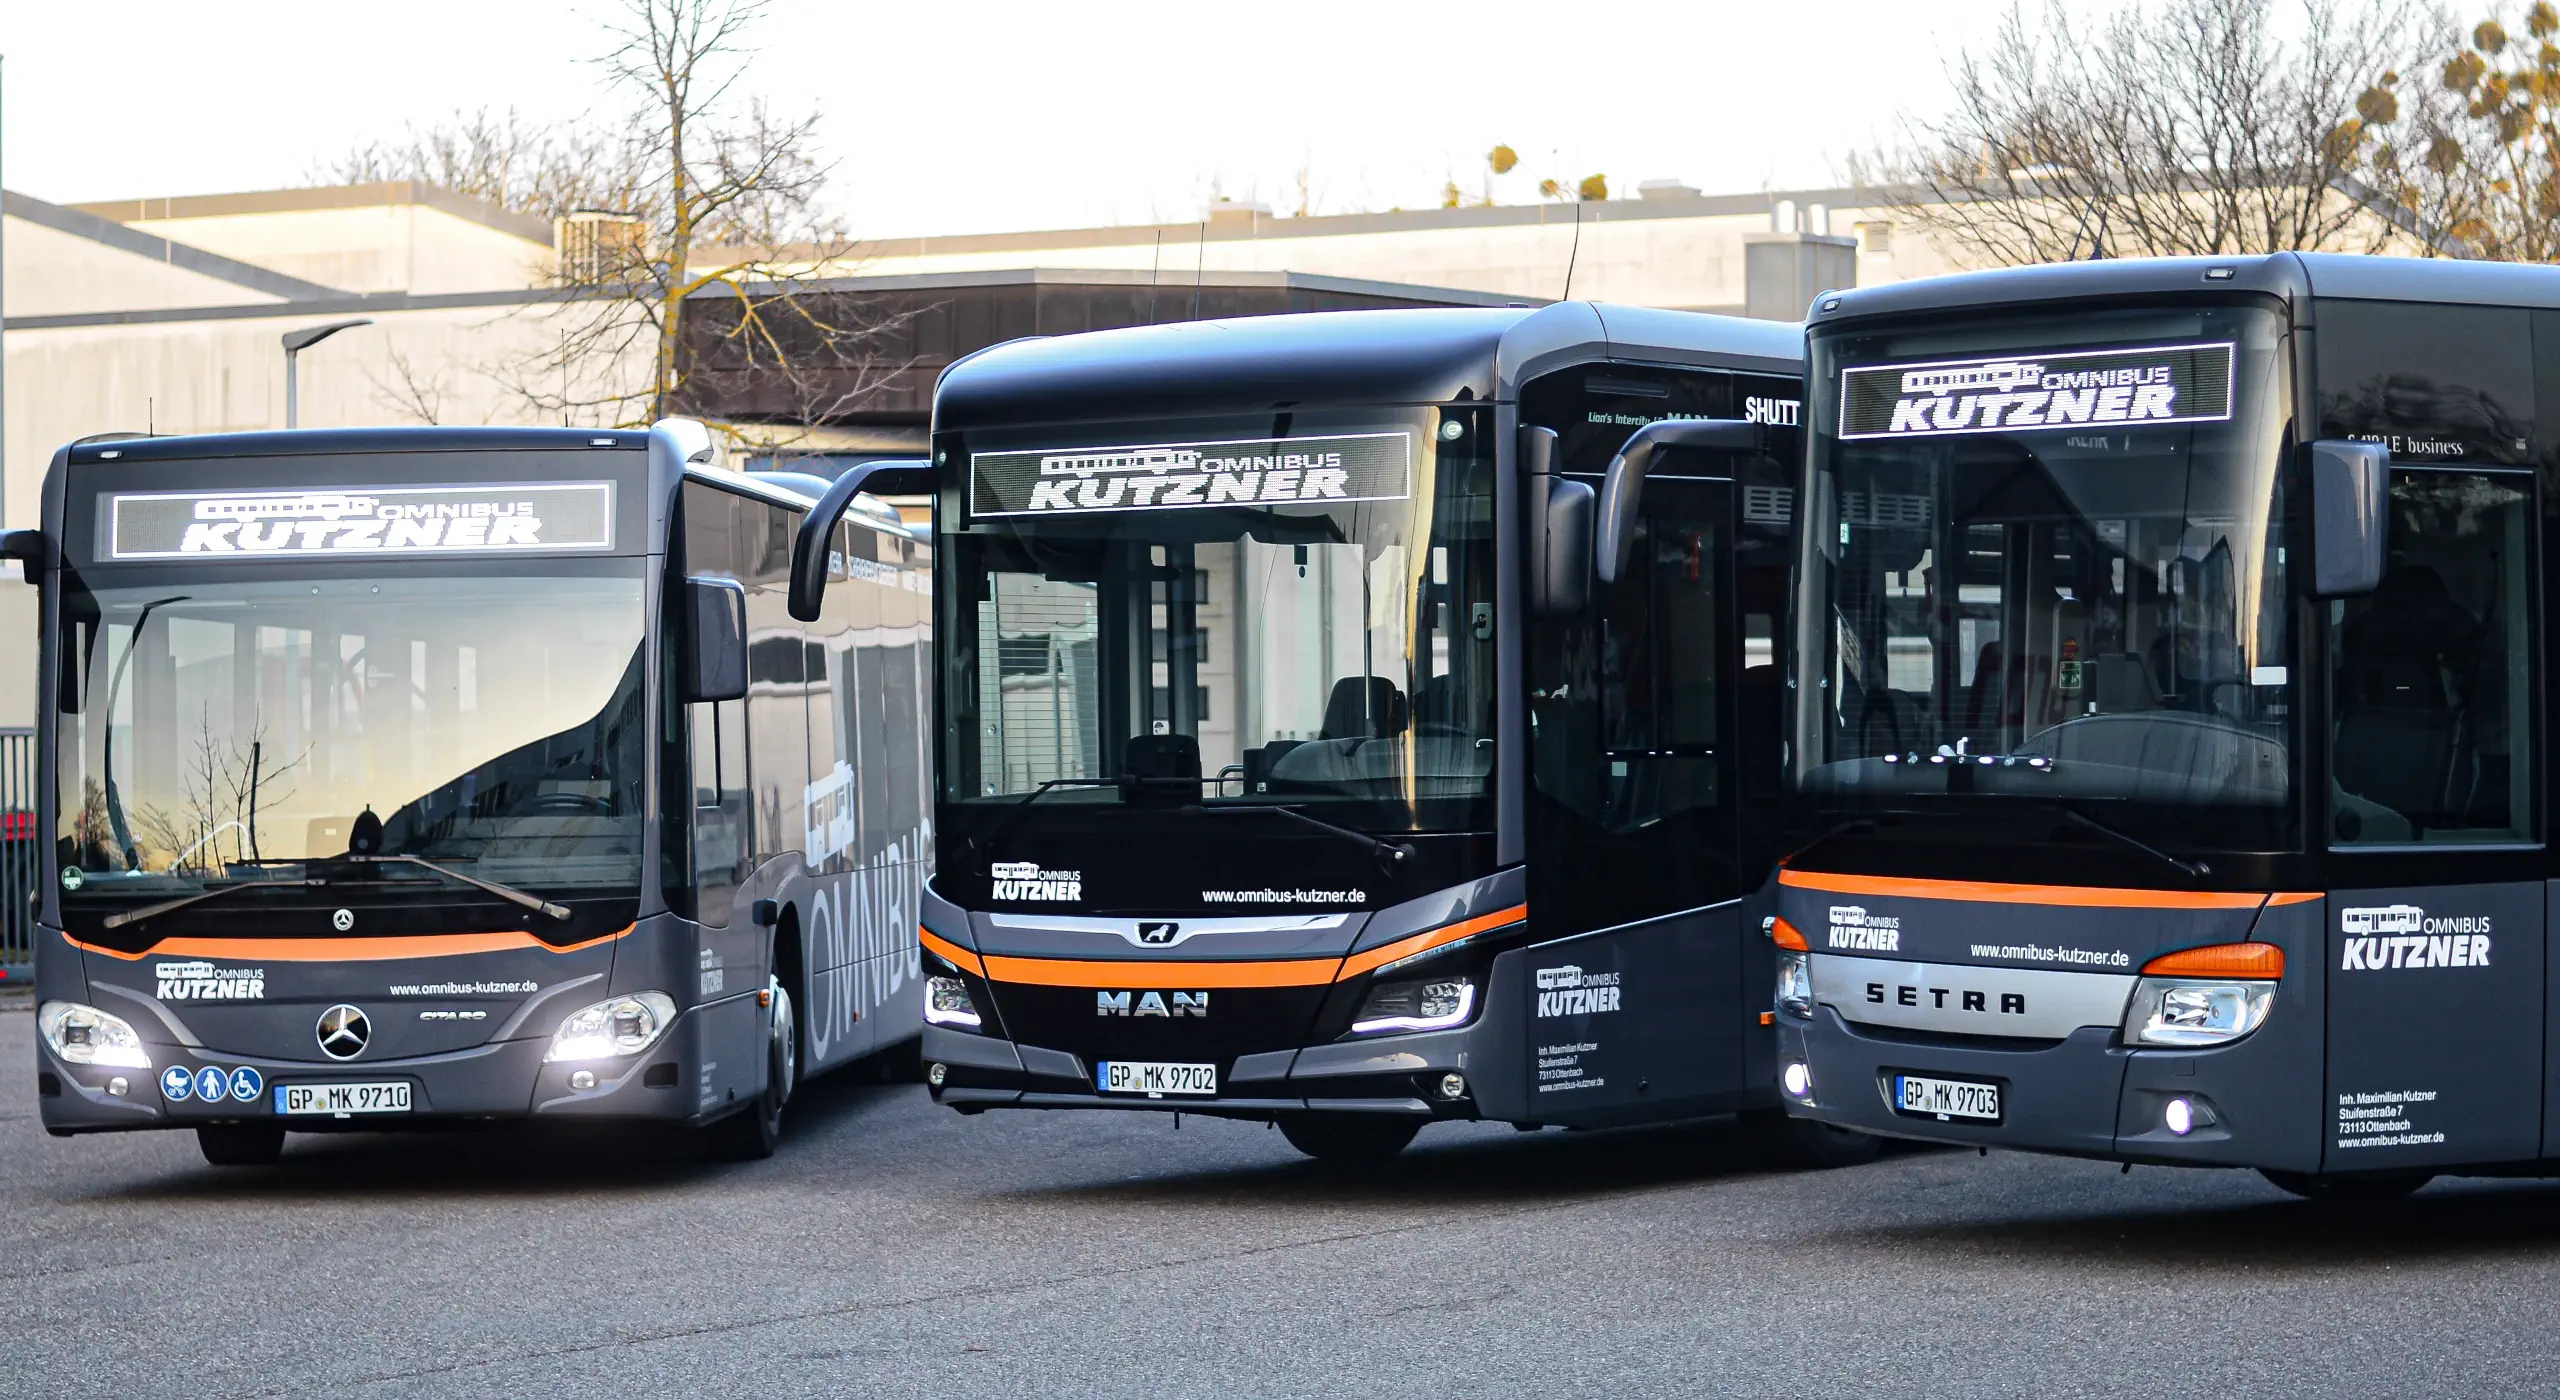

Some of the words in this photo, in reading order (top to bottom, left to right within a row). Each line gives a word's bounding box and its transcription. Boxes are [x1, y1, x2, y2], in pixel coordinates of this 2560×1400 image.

[2041, 367, 2169, 390] OMNIBUS
[1588, 412, 1612, 423] Lion's
[1888, 385, 2176, 432] KUTZNER
[2407, 437, 2463, 455] business
[1199, 453, 1341, 472] OMNIBUS
[1028, 470, 1350, 511] KUTZNER
[377, 501, 535, 520] OMNIBUS
[180, 516, 543, 552] KUTZNER
[1038, 870, 1081, 881] OMNIBUS
[992, 880, 1082, 901] KUTZNER
[1202, 888, 1366, 903] www.omnibus-kutzner.de
[1865, 915, 1899, 929] OMNIBUS
[2423, 916, 2490, 934] OMNIBUS
[1829, 925, 1899, 951] KUTZNER
[1970, 943, 2130, 967] www.omnibus-kutzner.de
[2342, 934, 2490, 970] KUTZNER
[214, 968, 264, 979] OMNIBUS
[1582, 972, 1620, 987] OMNIBUS
[156, 979, 265, 1000] KUTZNER
[389, 980, 538, 996] www.omnibus-kutzner.de
[1097, 991, 1208, 1017] MAN
[1537, 986, 1621, 1018] KUTZNER
[1867, 983, 2025, 1015] SETRA
[419, 1010, 488, 1021] CITARO
[1538, 1046, 1549, 1056] Inh.
[1549, 1043, 1577, 1055] Maximilian
[1577, 1042, 1598, 1052] Kutzner
[1573, 1054, 1578, 1065] 7
[1110, 1065, 1131, 1088] GP
[1144, 1066, 1166, 1089] MK
[1170, 1066, 1214, 1090] 9702
[1538, 1069, 1556, 1081] 73113
[1555, 1066, 1583, 1079] Ottenbach
[1538, 1076, 1605, 1093] www.omnibus-kutzner.de
[288, 1089, 313, 1110] GP
[328, 1087, 354, 1109] MK
[359, 1086, 409, 1109] 9710
[1905, 1080, 1924, 1107] GP
[1934, 1083, 1953, 1111] MK
[1957, 1086, 1997, 1115] 9703
[2339, 1093, 2356, 1105] Inh.
[2356, 1091, 2403, 1105] Maximilian
[2402, 1089, 2437, 1102] Kutzner
[2339, 1105, 2397, 1120] Stuifenstraße
[2396, 1104, 2404, 1117] 7
[2339, 1121, 2366, 1134] 73113
[2365, 1118, 2411, 1133] Ottenbach
[2338, 1131, 2445, 1149] www.omnibus-kutzner.de
